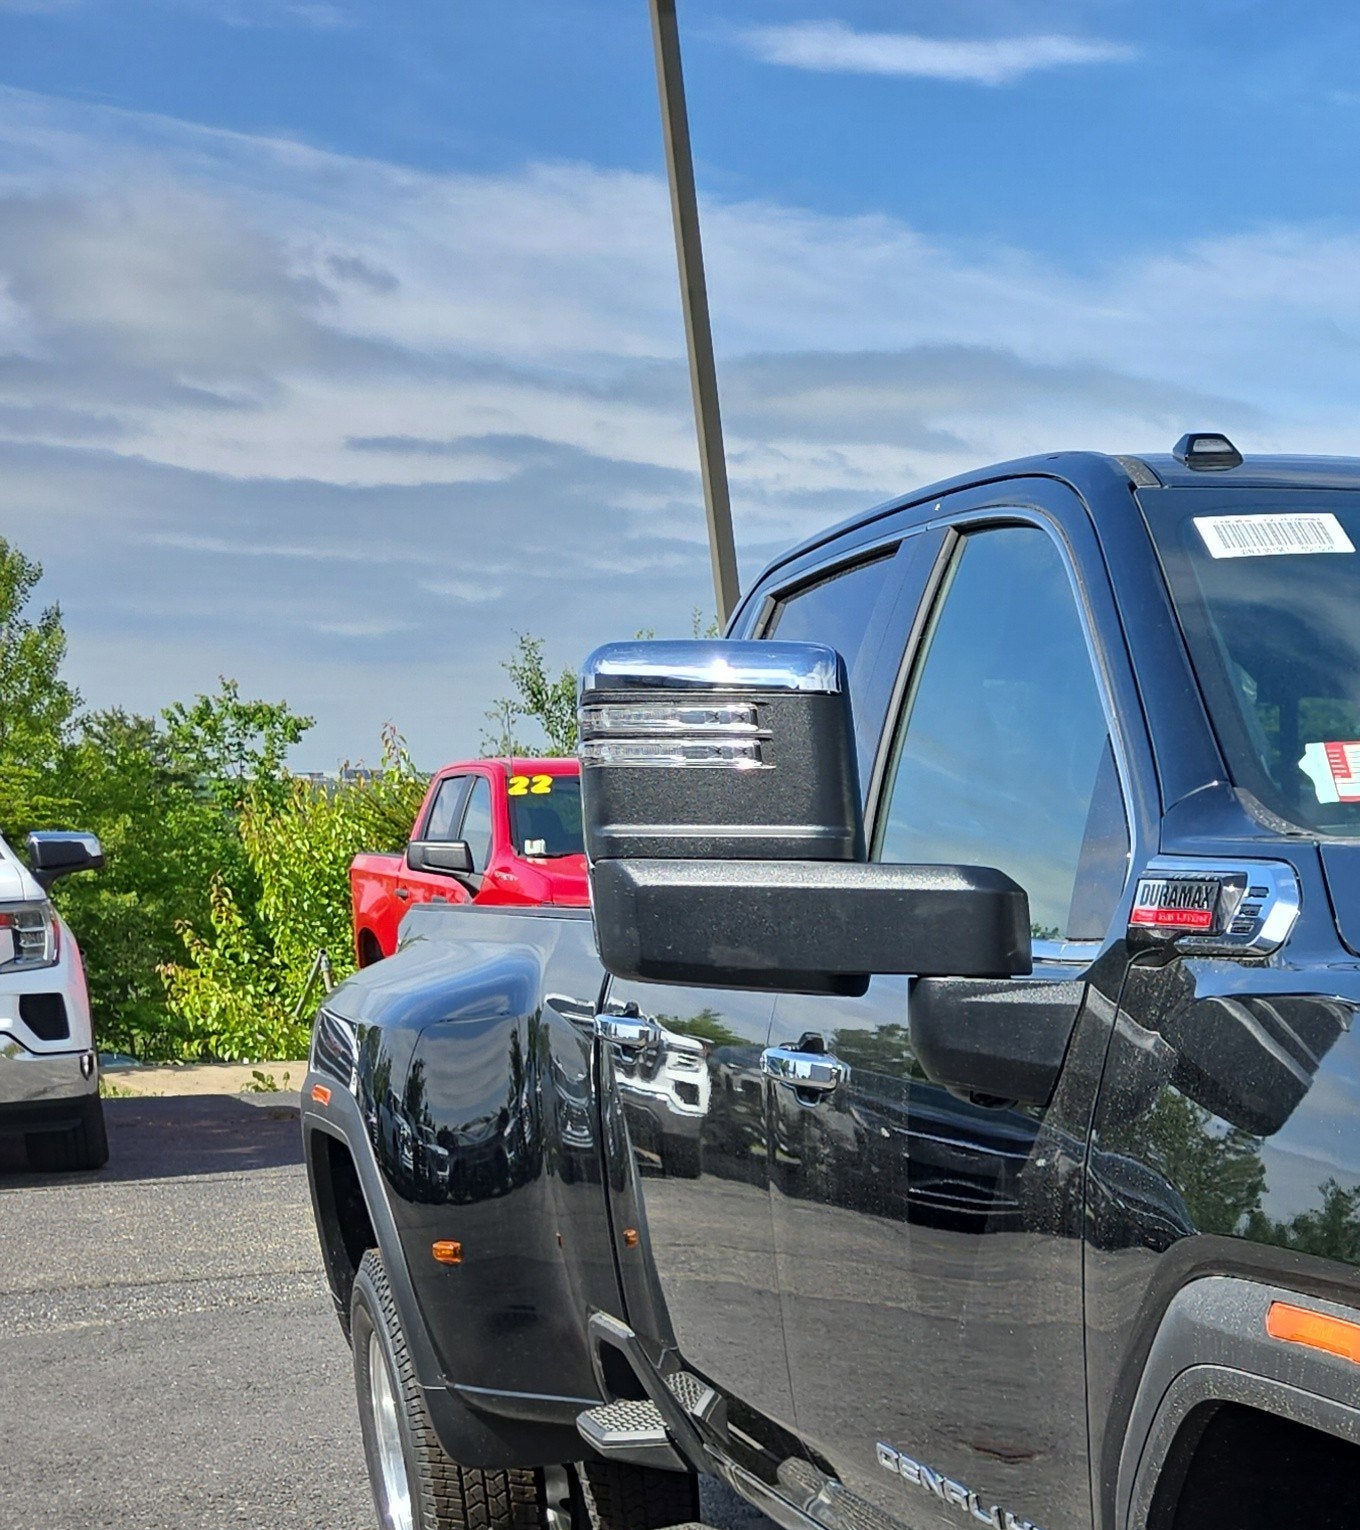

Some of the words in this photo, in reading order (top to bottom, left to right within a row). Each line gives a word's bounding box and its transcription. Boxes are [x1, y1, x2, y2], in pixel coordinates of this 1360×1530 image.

[508, 774, 553, 796] 22
[1139, 883, 1214, 910] DURAMAX
[876, 1441, 1003, 1530] DENALI
